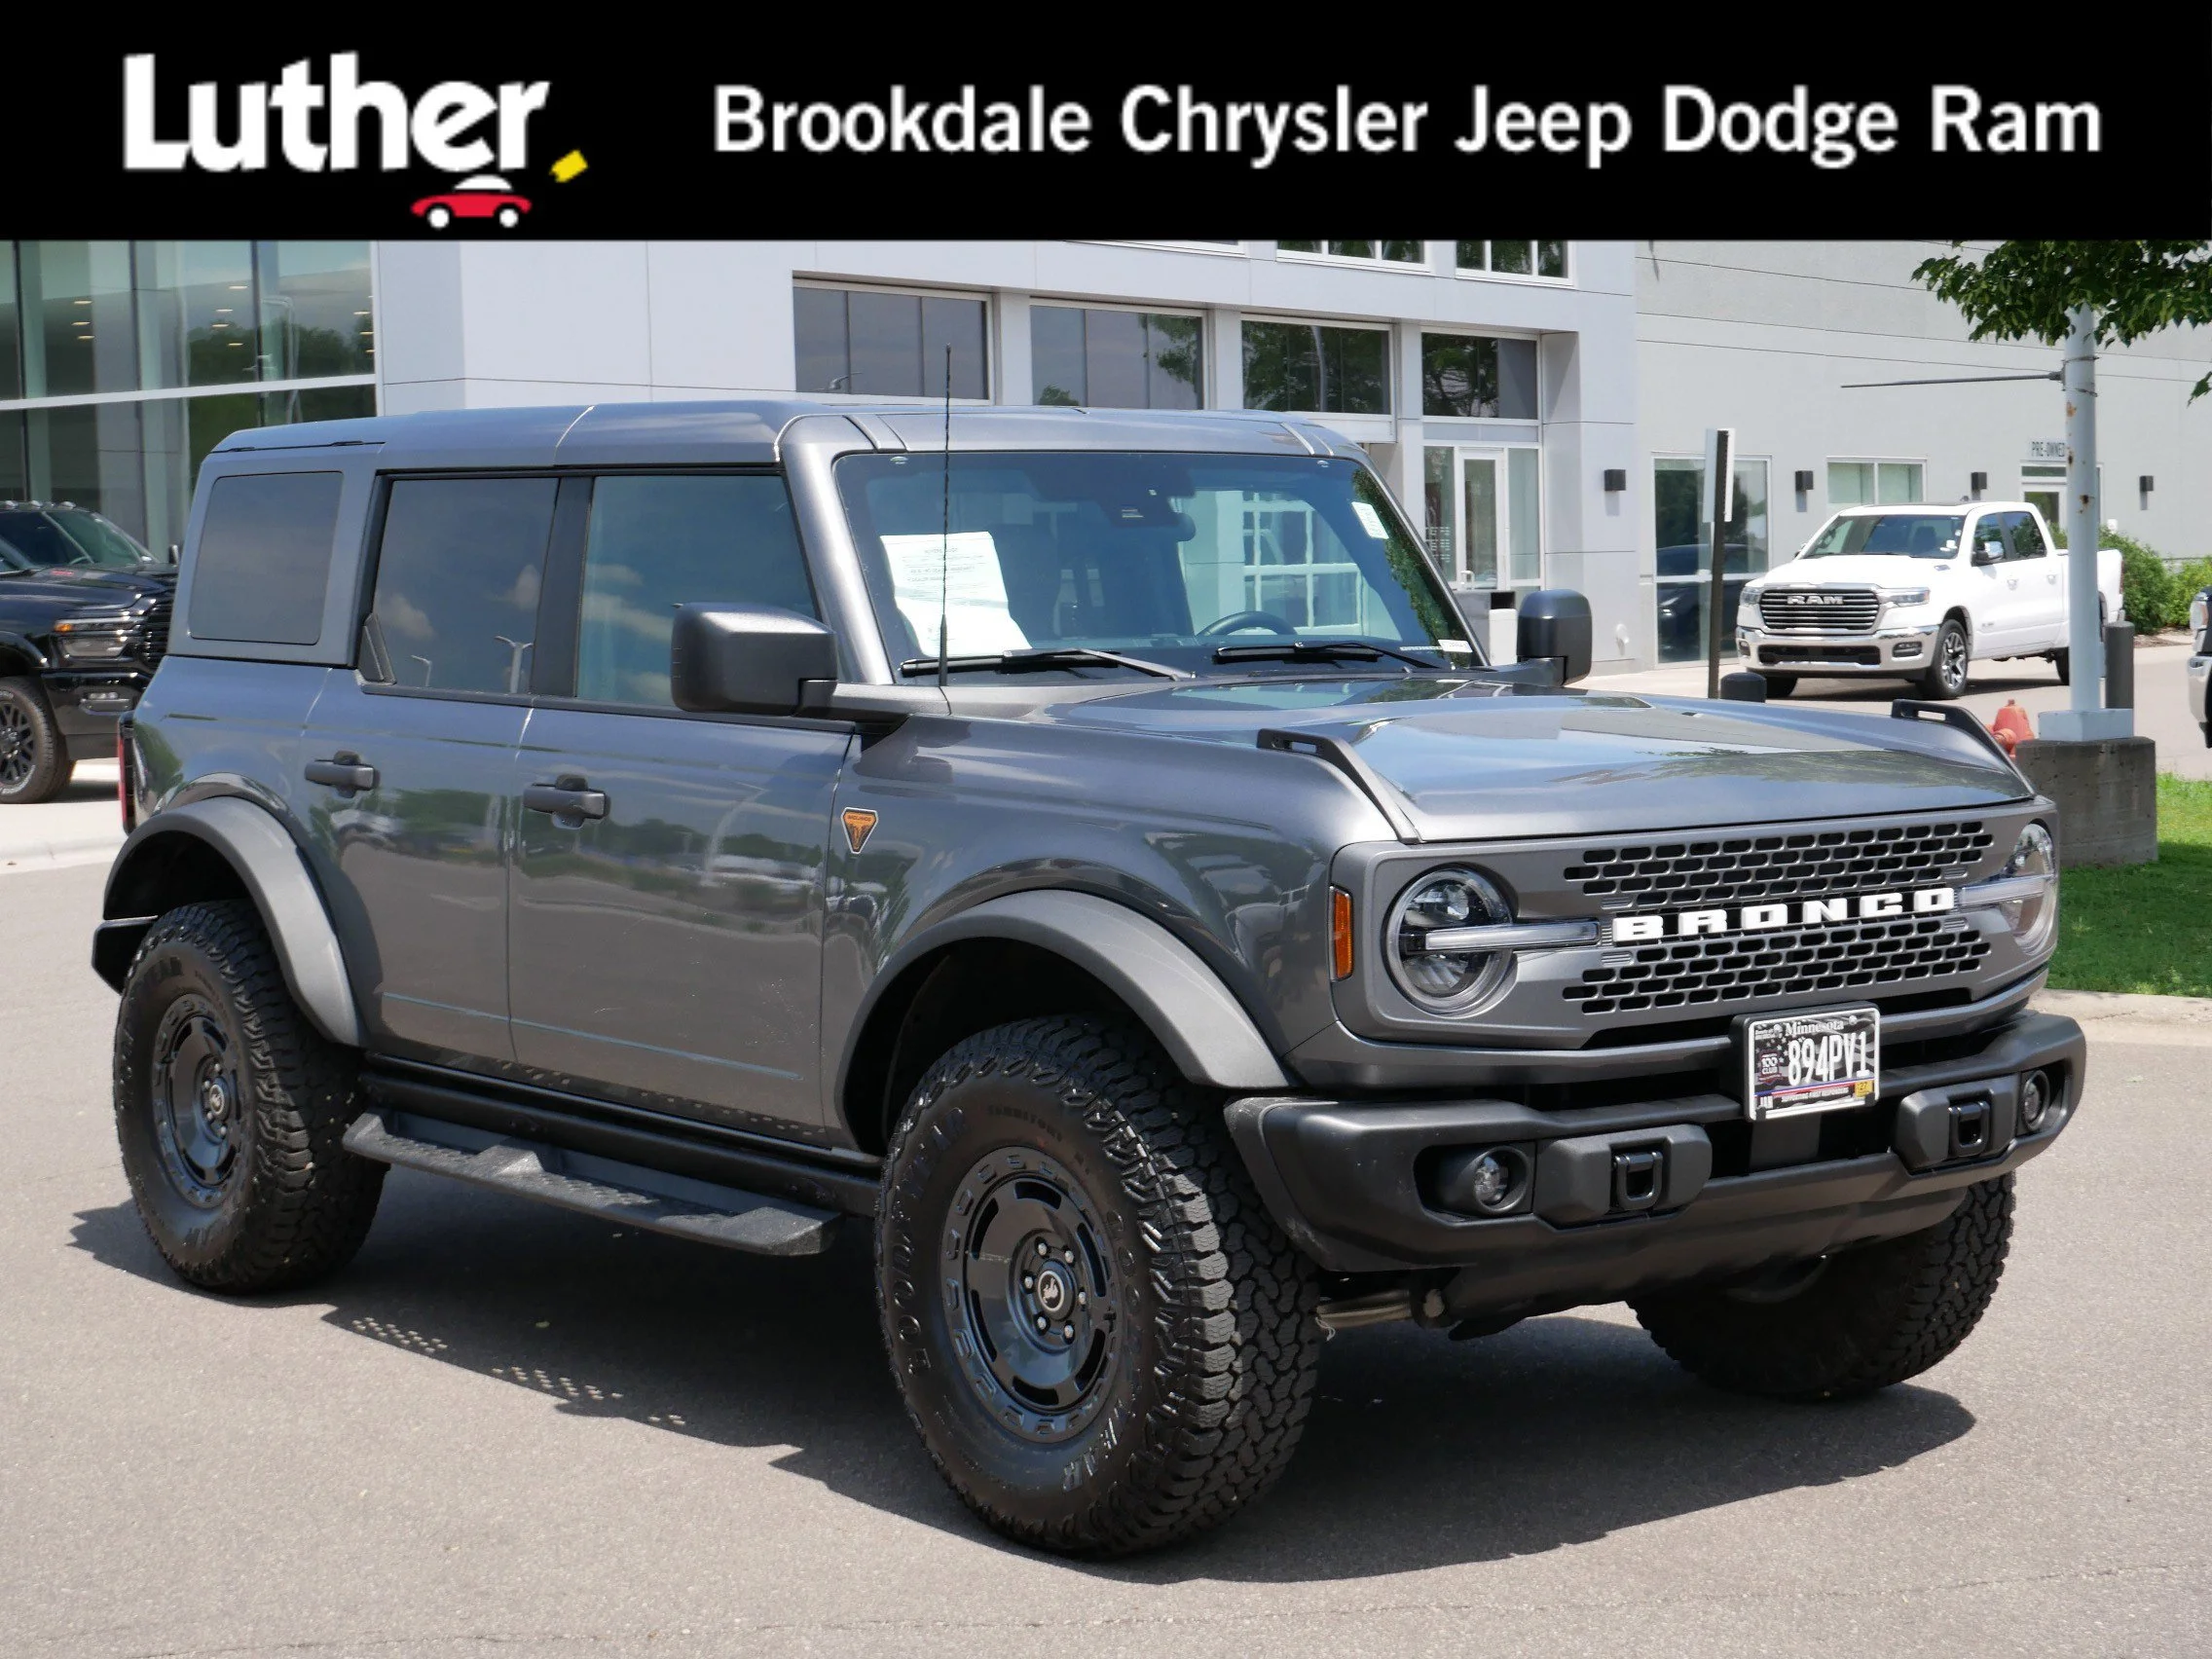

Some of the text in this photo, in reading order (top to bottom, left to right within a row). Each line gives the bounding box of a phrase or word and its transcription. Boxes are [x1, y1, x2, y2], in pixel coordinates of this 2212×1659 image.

[1787, 595, 1844, 605] RAM
[1612, 887, 1955, 942] BRONCO
[1785, 1020, 1845, 1037] Minnesota
[1788, 1031, 1870, 1087] 894PV1
